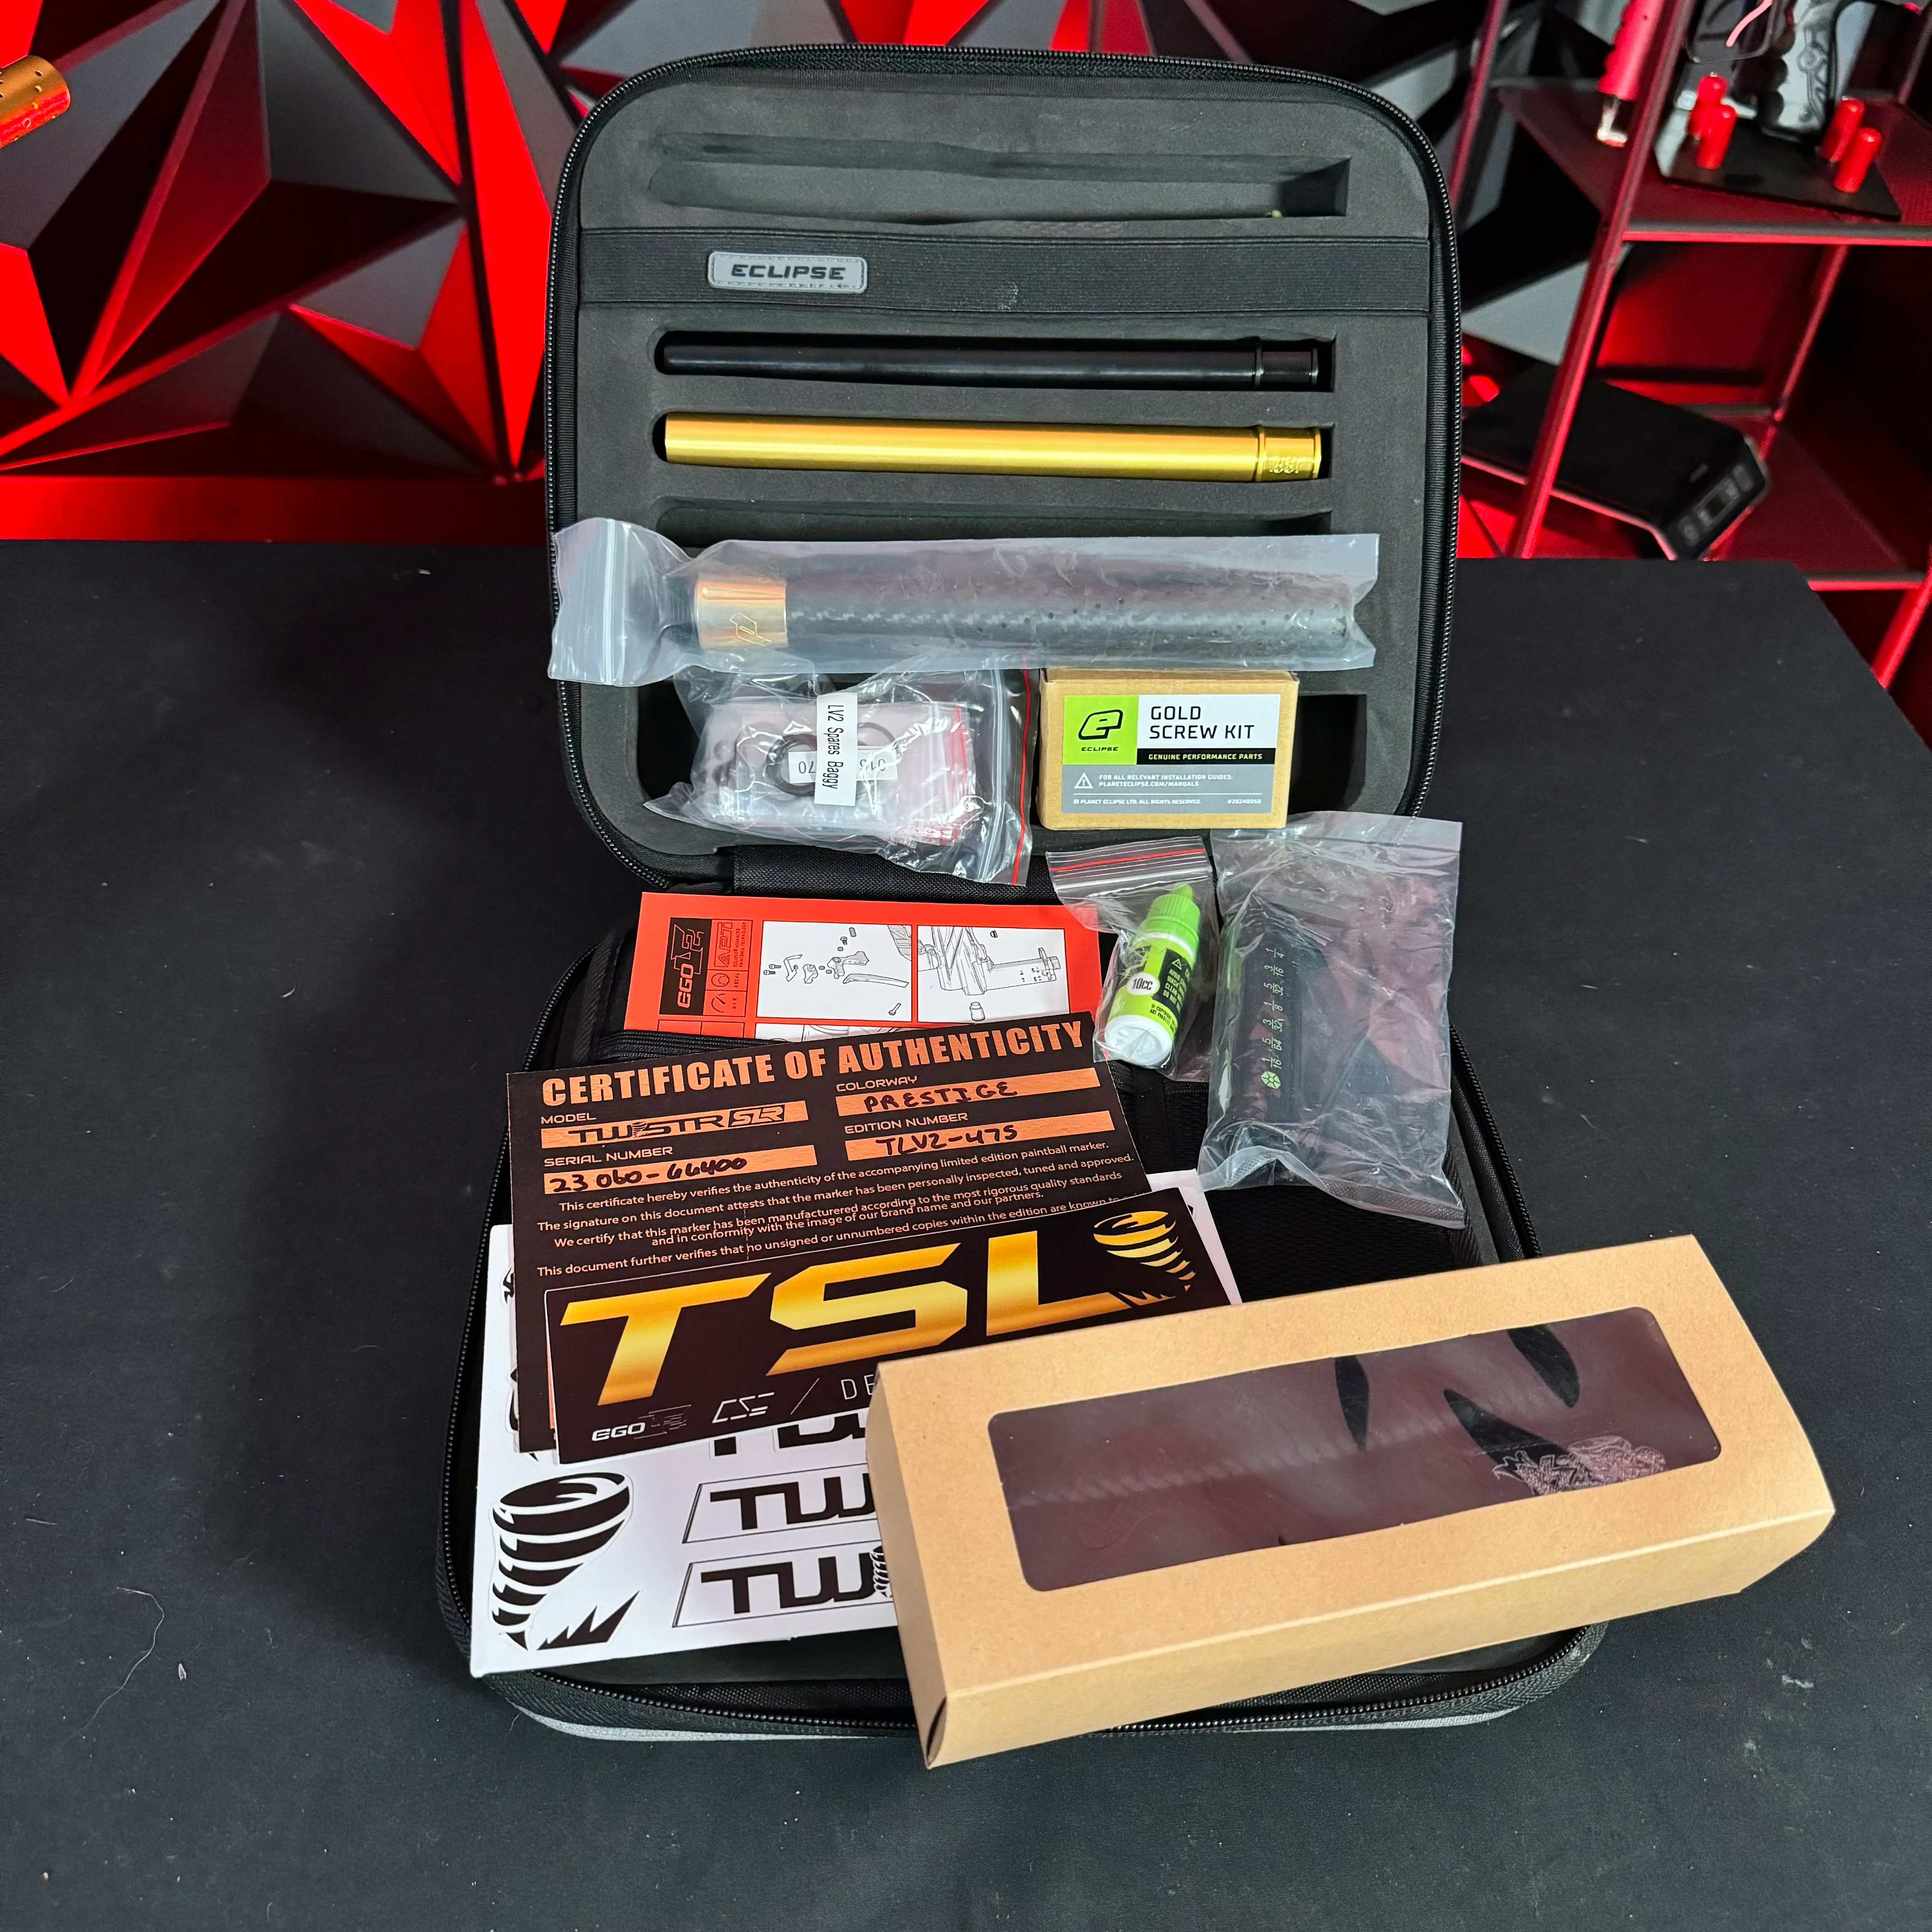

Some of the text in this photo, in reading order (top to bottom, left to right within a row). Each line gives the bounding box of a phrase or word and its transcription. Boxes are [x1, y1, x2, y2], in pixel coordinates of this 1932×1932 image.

[731, 264, 846, 280] ECLIPSE
[1150, 706, 1201, 720] GOLD
[822, 705, 844, 789] LV2 Spares Baggy
[1149, 725, 1255, 740] SCREW KIT
[677, 963, 694, 1008] EGO
[542, 1021, 1083, 1107] CERTIFICATE OF AUTHENTICITY
[836, 1076, 918, 1092] COLORWAY
[864, 1081, 1018, 1113] PRESTIGE
[541, 1113, 597, 1124] MODEL
[844, 1112, 968, 1134] EDITION NUMBER
[544, 1146, 673, 1167] SERIAL NUMBER
[537, 1221, 561, 1231] The
[563, 1217, 619, 1230] signature
[639, 1211, 662, 1221] this
[664, 1204, 724, 1218] document
[727, 1200, 765, 1210] attests
[767, 1196, 791, 1206] that
[792, 1193, 811, 1203] the
[814, 1189, 853, 1201] marker
[855, 1187, 875, 1195] has
[877, 1183, 906, 1192] been
[908, 1174, 964, 1191] personally
[966, 1167, 1021, 1182] inspected,
[1023, 1163, 1056, 1174] tuned
[1058, 1160, 1079, 1170] and
[1080, 1153, 1135, 1168] approved.
[558, 1142, 1110, 1211] This certificate hereby verifies the authenticity of the accompanying limited edition paintball marker.
[554, 1238, 574, 1247] We
[576, 1233, 615, 1246] certify
[617, 1230, 643, 1241] that
[644, 1228, 667, 1237] this
[670, 1223, 711, 1236] marker
[713, 1220, 733, 1231] has
[736, 1215, 765, 1227] been
[768, 1203, 859, 1224] manufacturered
[861, 1198, 916, 1214] according
[932, 1193, 951, 1202] the
[953, 1189, 981, 1200] most
[983, 1185, 1029, 1200] rigorous
[1030, 1179, 1067, 1194] quality
[1069, 1171, 1122, 1185] standards
[652, 1232, 674, 1246] and
[677, 1230, 688, 1243] in
[690, 1222, 754, 1241] conformity
[757, 1218, 783, 1233] with
[785, 1215, 805, 1229] the
[807, 1211, 842, 1227] image
[844, 1210, 856, 1222] of
[859, 1212, 878, 1220] our
[880, 1205, 914, 1217] brand
[916, 1204, 948, 1213] name
[951, 1195, 971, 1209] and
[994, 1191, 1043, 1205] partners.
[537, 1266, 562, 1276] This
[565, 1259, 628, 1274] document
[630, 1254, 673, 1266] further
[675, 1248, 718, 1260] verifies
[720, 1245, 744, 1255] that
[746, 1243, 762, 1253] no
[764, 1234, 818, 1249] unsigned
[836, 1223, 910, 1240] unnumbered
[912, 1220, 948, 1234] copies
[950, 1214, 985, 1226] within
[987, 1211, 1007, 1220] the
[1008, 1207, 1048, 1218] edition
[1050, 1205, 1067, 1214] are
[560, 1230, 1131, 1406] TSL
[592, 1422, 646, 1441] EGO
